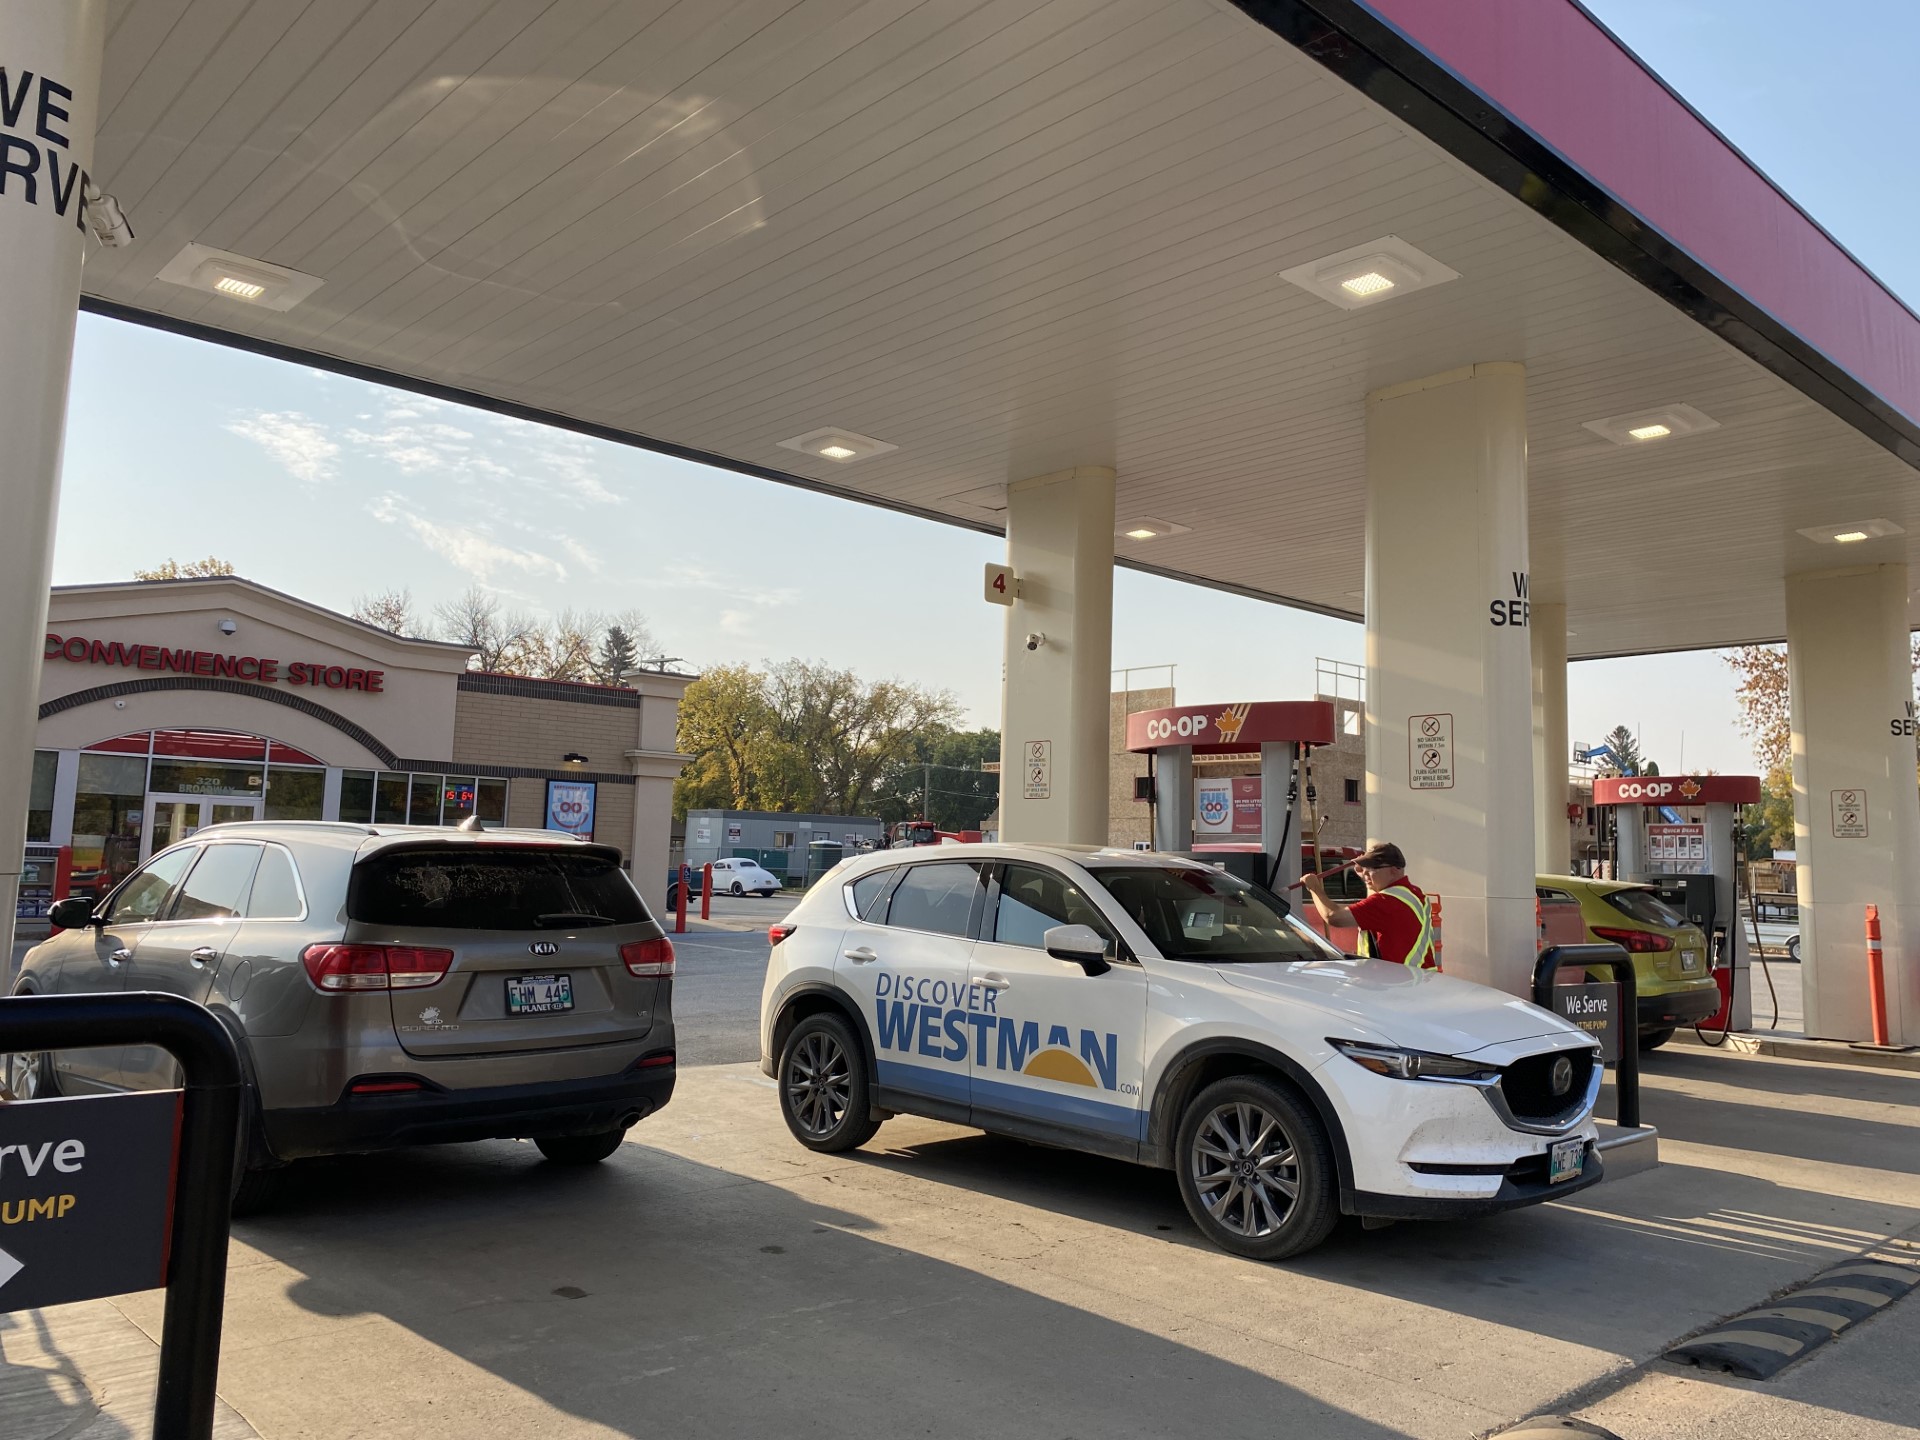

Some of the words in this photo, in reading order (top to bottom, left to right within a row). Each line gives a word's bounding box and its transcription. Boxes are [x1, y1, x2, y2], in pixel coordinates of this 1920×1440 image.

[993, 573, 1006, 594] 4
[44, 633, 279, 683] CONVENIENCE
[287, 662, 385, 693] STORE
[1147, 714, 1208, 740] CO-OP
[195, 777, 220, 785] 320
[178, 783, 235, 794] BROADWAY
[1618, 783, 1672, 798] CO-OP
[461, 791, 473, 800] 64
[553, 790, 590, 803] FUEL
[1200, 792, 1228, 803] FUEL
[1200, 802, 1229, 812] GOOD
[1206, 812, 1222, 820] DAY
[534, 943, 556, 953] KIA
[544, 984, 570, 1002] 445
[875, 972, 998, 1014] DISCOVER
[521, 1003, 551, 1013] PLANET
[1566, 995, 1581, 1015] We
[1582, 995, 1608, 1013] Serve
[1582, 1021, 1593, 1030] THE
[1593, 1020, 1608, 1029] PUMP
[875, 998, 1118, 1092] WESTMAN
[1118, 1082, 1140, 1097] .COM
[2, 1194, 76, 1225] UMP
